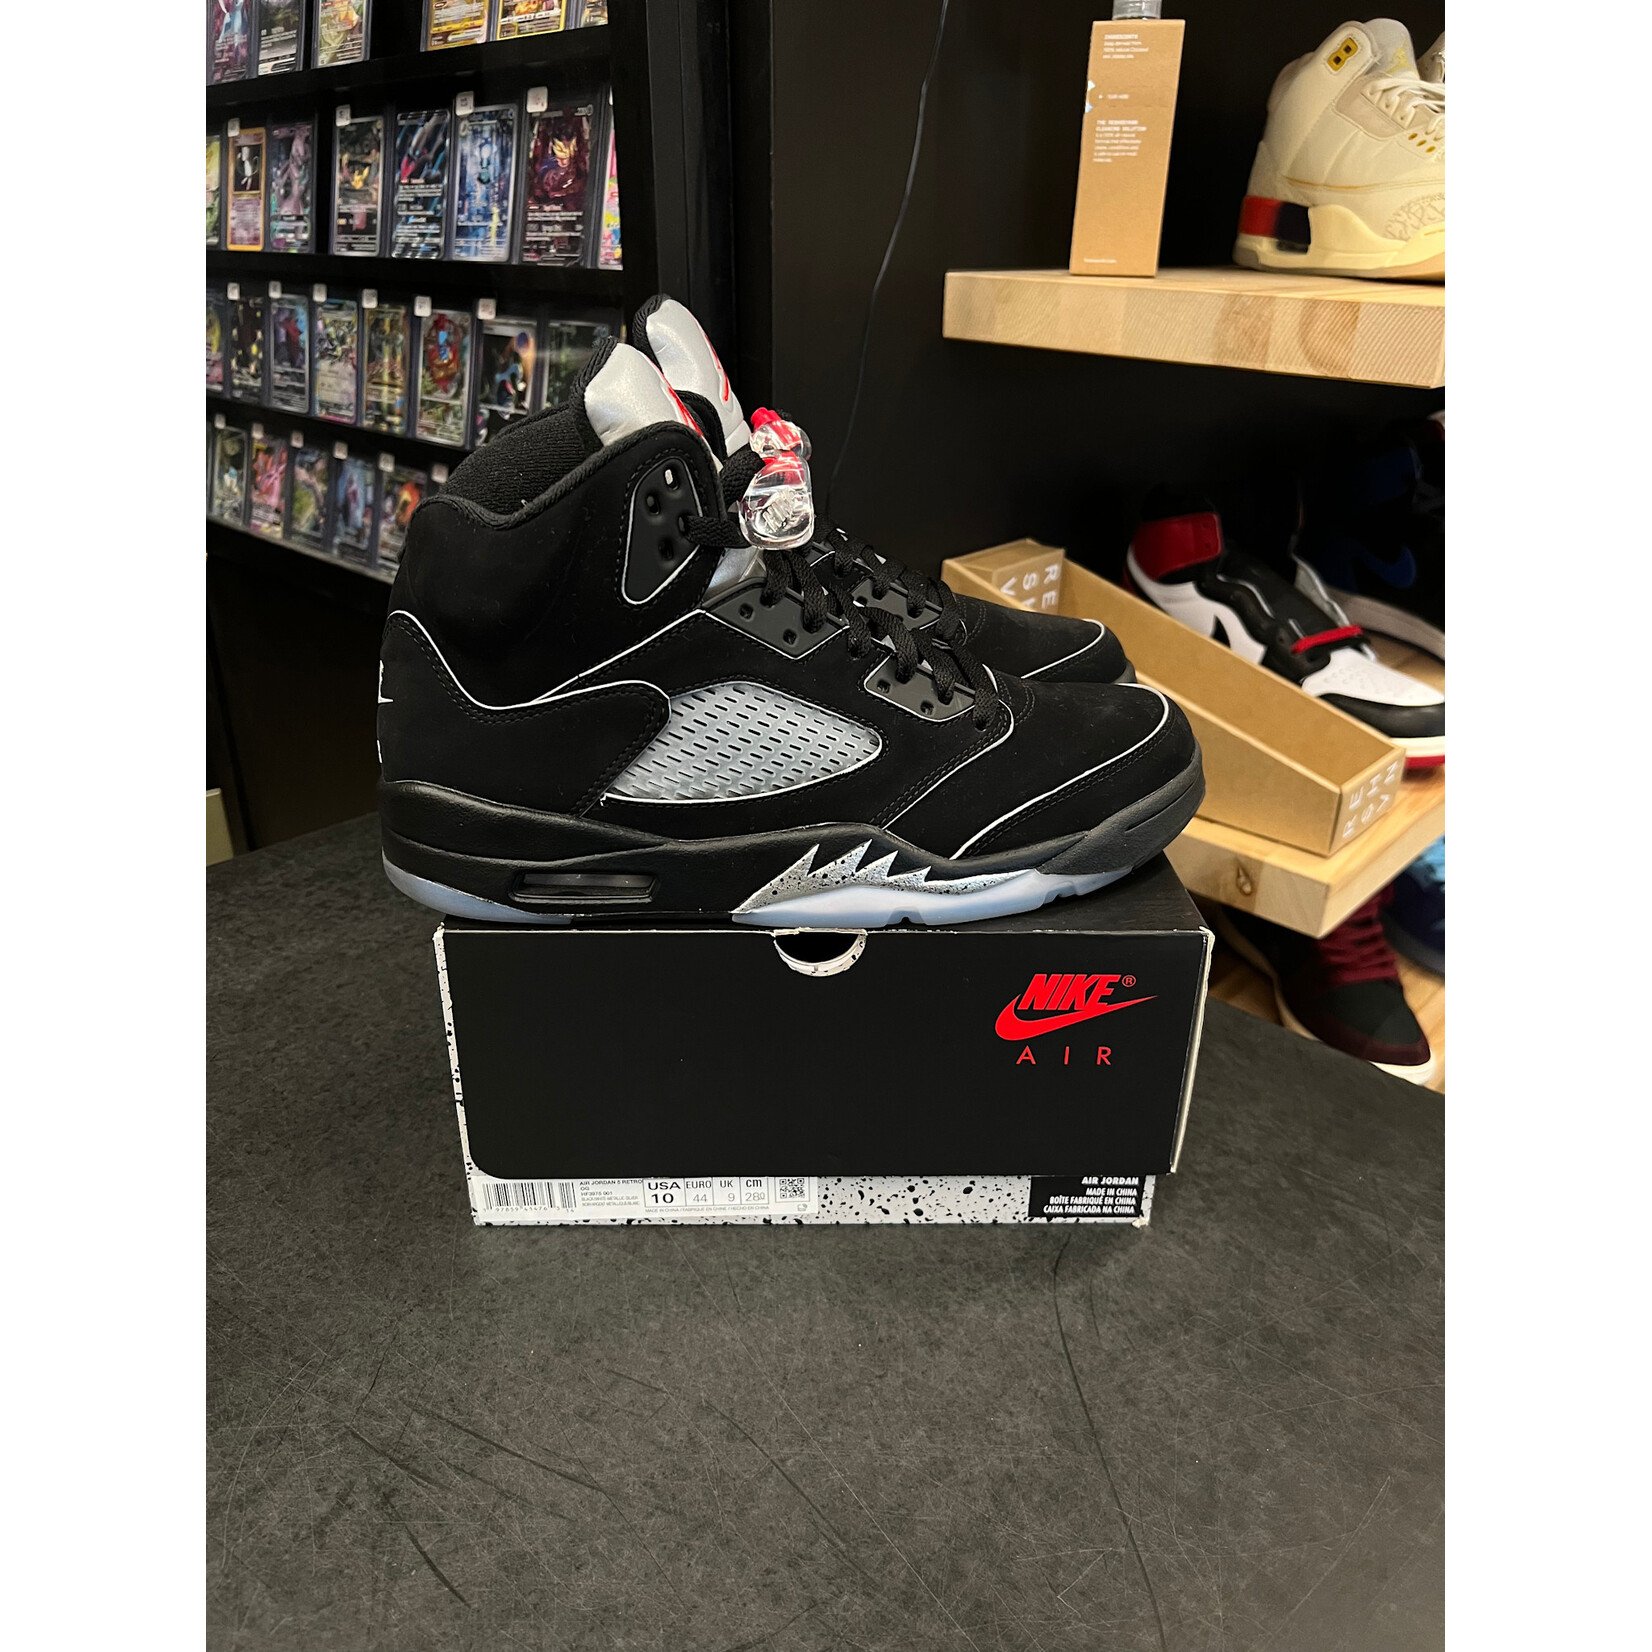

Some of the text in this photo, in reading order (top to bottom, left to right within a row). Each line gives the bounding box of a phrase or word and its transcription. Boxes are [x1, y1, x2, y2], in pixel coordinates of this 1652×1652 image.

[1017, 974, 1121, 1010] NIKE
[1016, 1045, 1112, 1066] AIR
[686, 1180, 712, 1189] EURO
[720, 1180, 734, 1188] UK
[746, 1179, 762, 1188] cm
[1081, 1176, 1139, 1185] AIR JORDAN
[648, 1182, 681, 1190] USA
[1086, 1188, 1138, 1196] MADE IN CHINA
[651, 1193, 674, 1204] 10
[693, 1194, 707, 1202] 44
[728, 1192, 735, 1202] 9
[1050, 1195, 1070, 1205] BOÎTE
[1104, 1197, 1114, 1205] EN
[1115, 1197, 1136, 1205] CHINA
[1043, 1206, 1064, 1214] CAIXA
